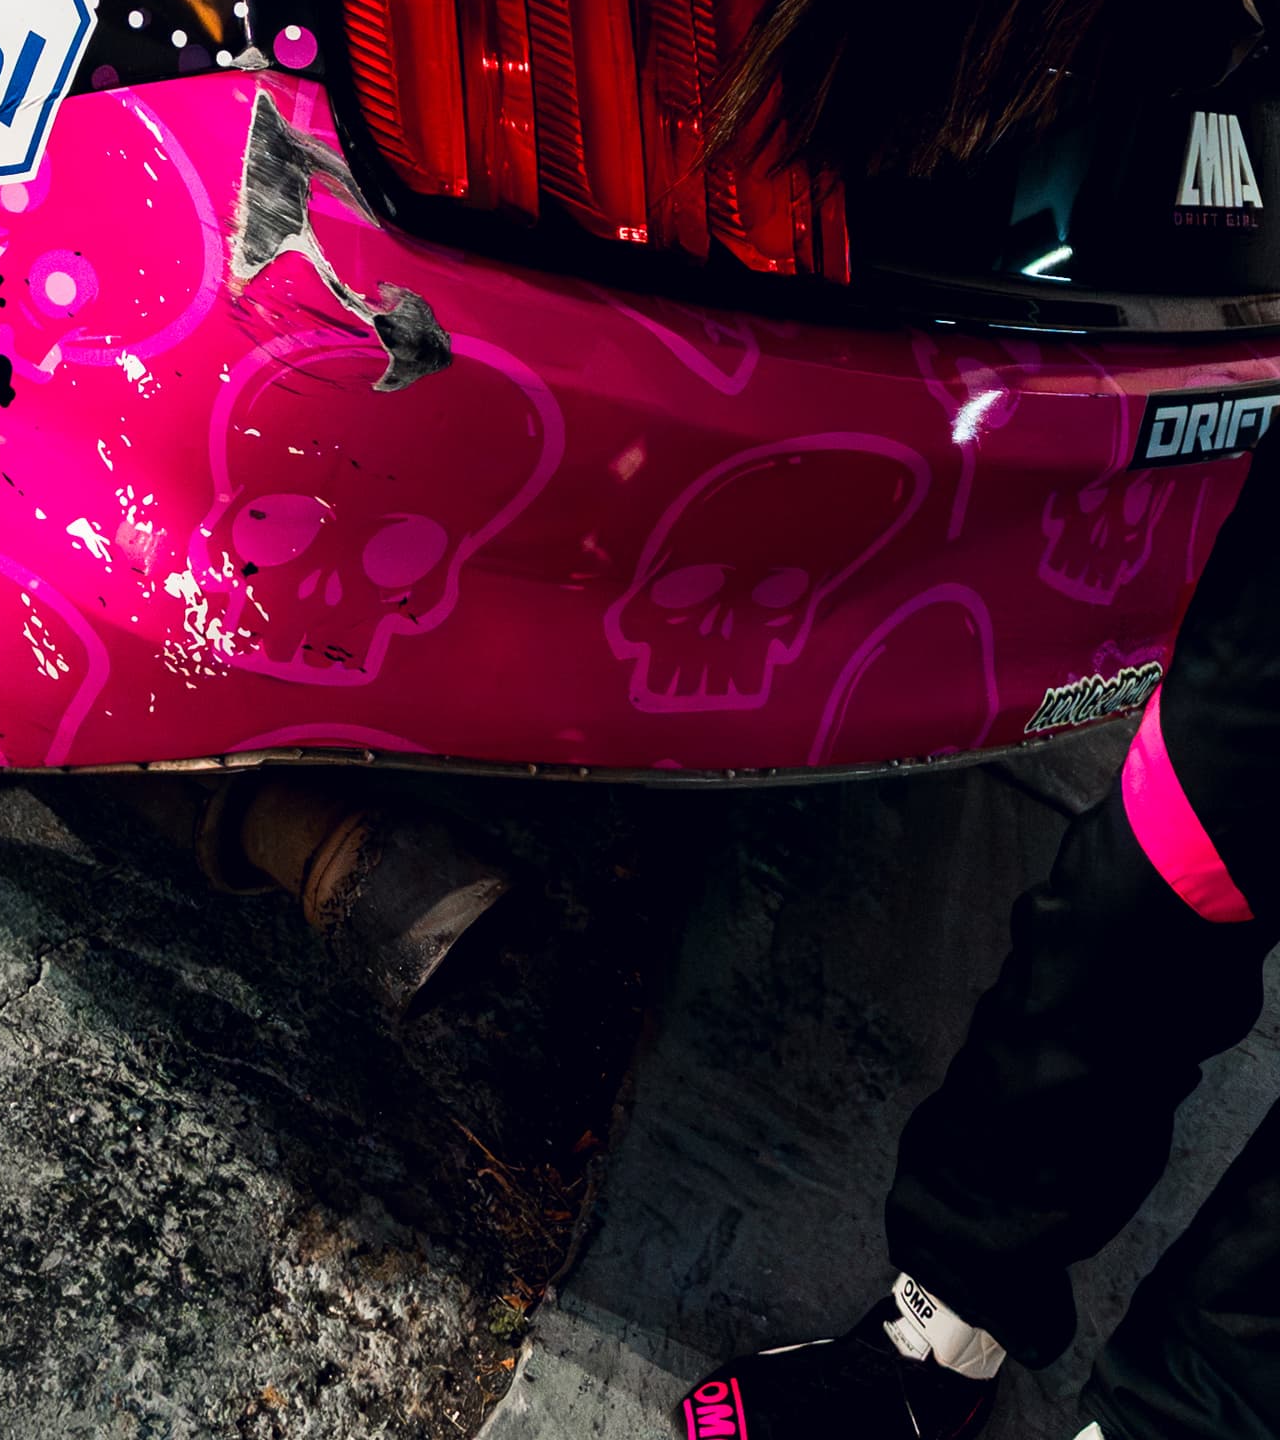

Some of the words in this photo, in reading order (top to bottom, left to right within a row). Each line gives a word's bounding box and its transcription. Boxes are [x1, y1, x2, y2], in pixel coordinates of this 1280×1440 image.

[1175, 110, 1264, 208] MIA
[1173, 211, 1218, 227] DRIFT
[1226, 212, 1259, 228] GIRL
[904, 1280, 933, 1320] OMP
